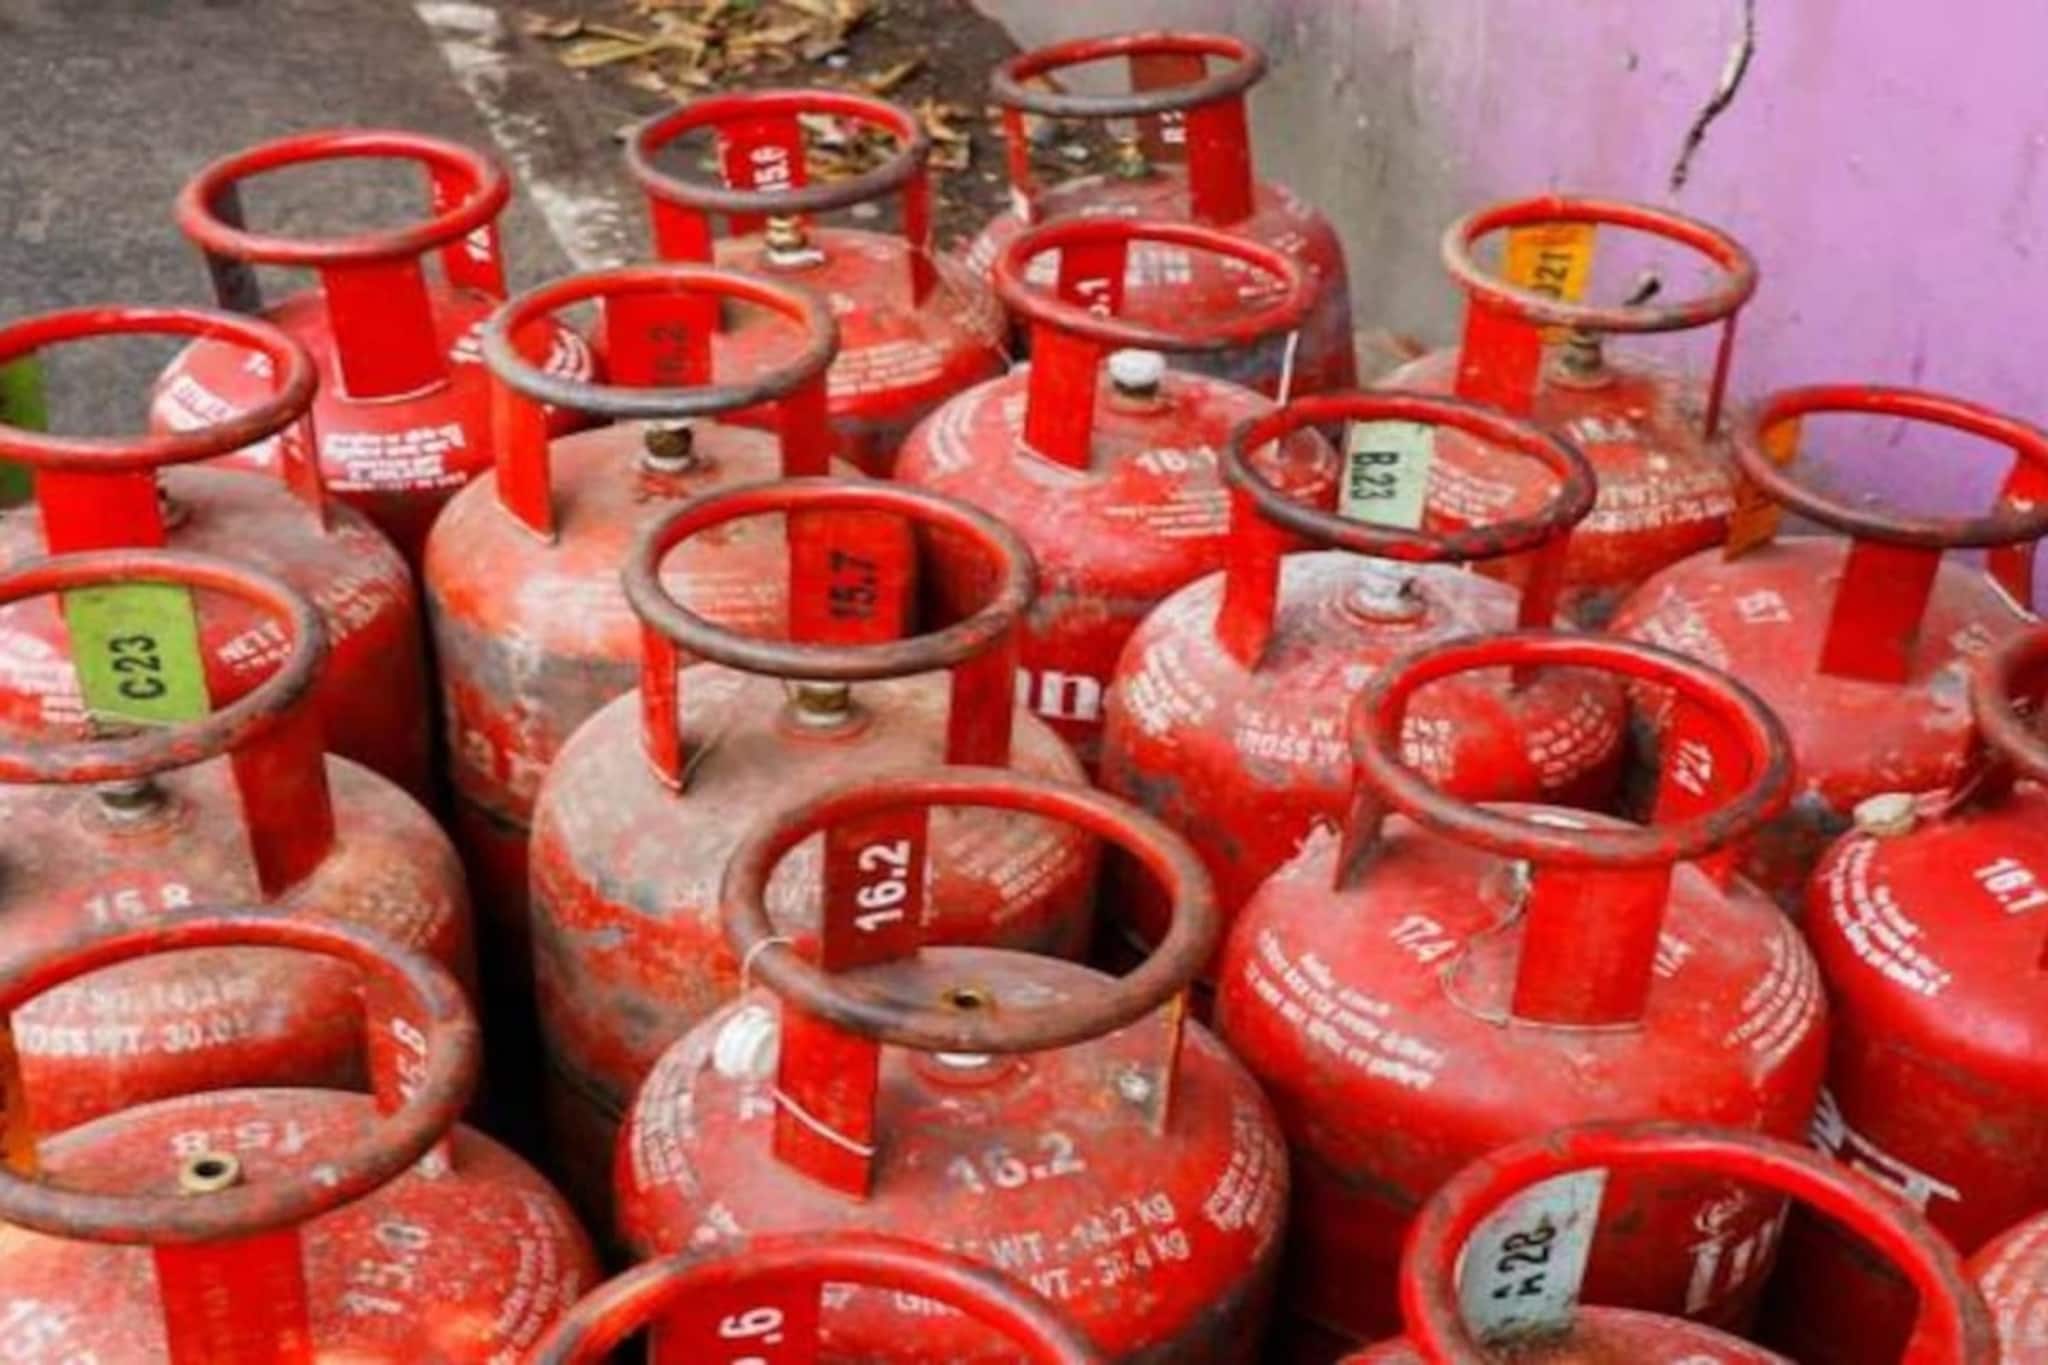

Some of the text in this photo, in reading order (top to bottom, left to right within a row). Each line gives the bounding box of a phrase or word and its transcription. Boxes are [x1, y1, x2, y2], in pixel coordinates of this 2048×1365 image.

[1350, 451, 1399, 500] B.23
[828, 548, 878, 619] 15.7
[106, 632, 168, 702] C23
[854, 840, 911, 932] 16.2
[947, 1130, 1087, 1196] 16.2
